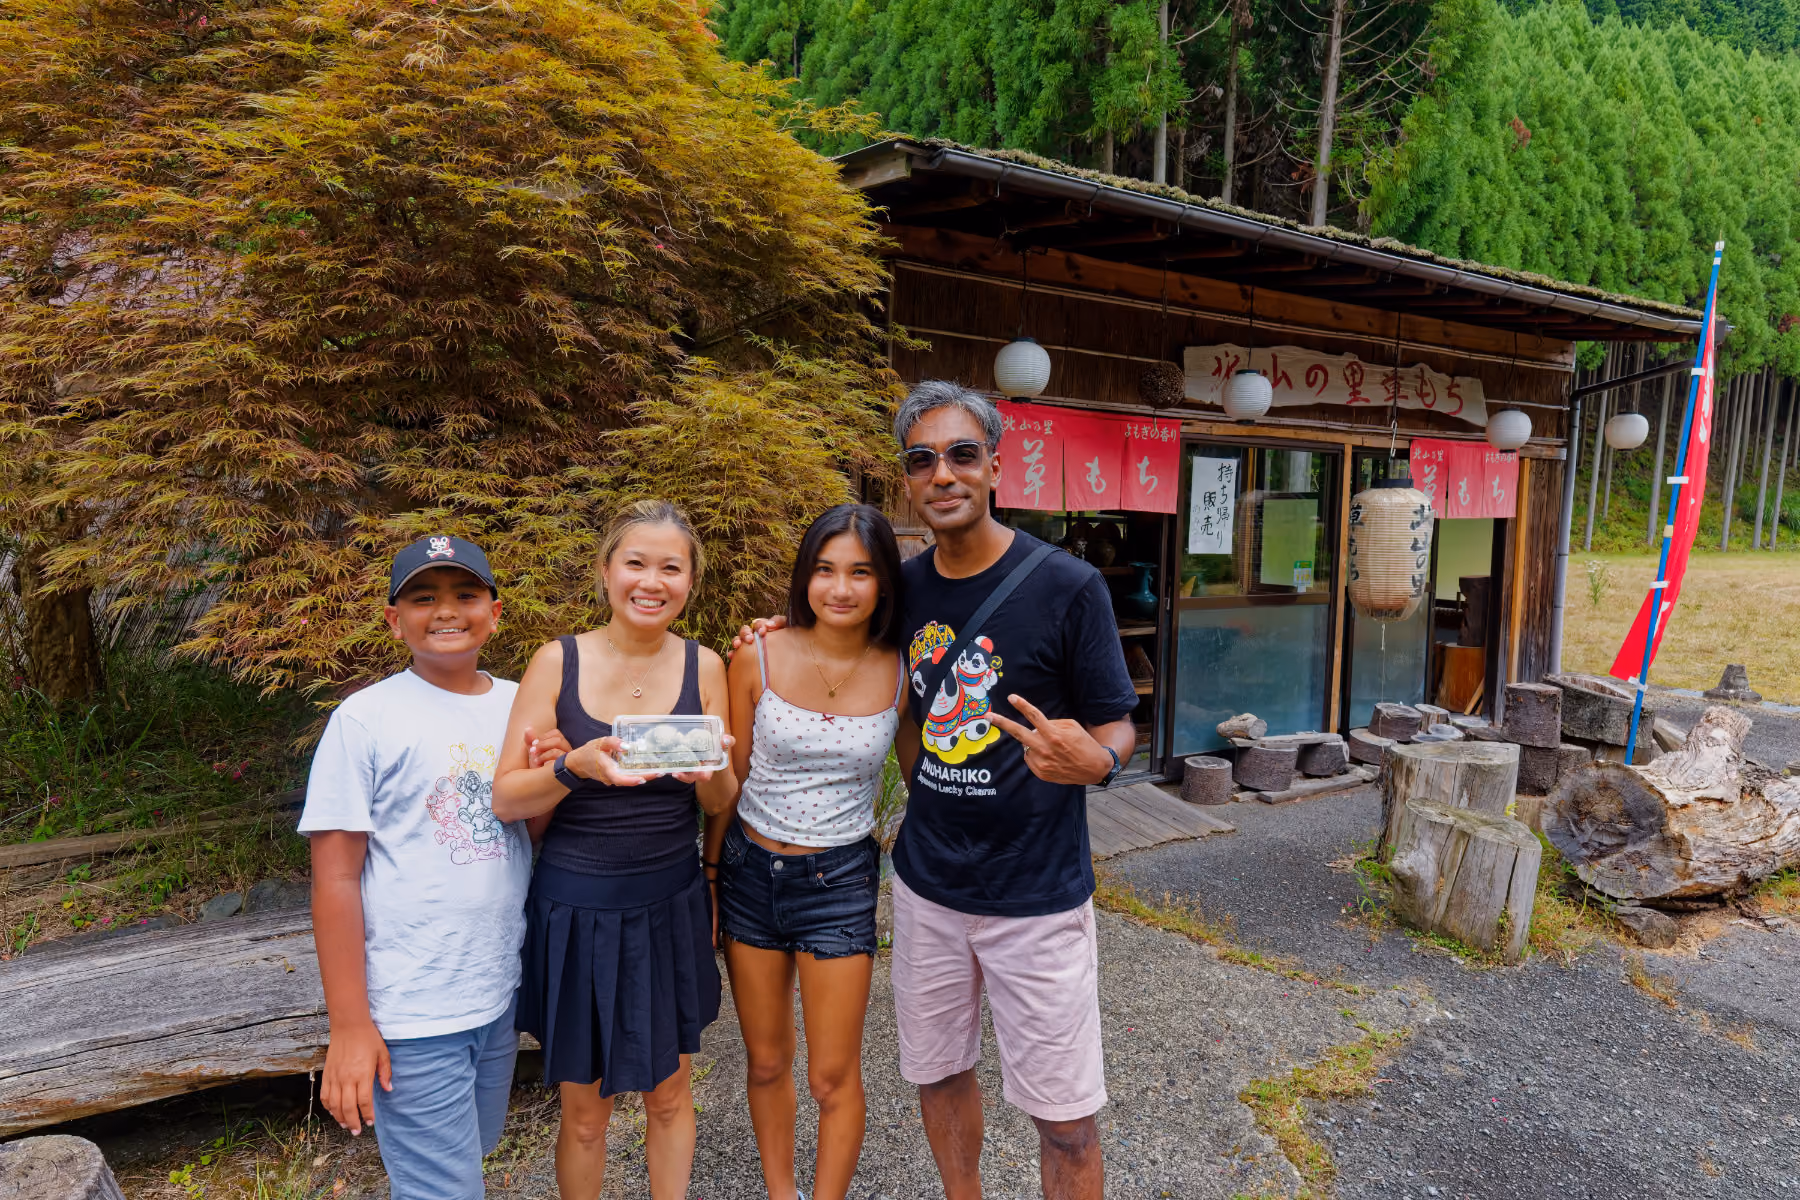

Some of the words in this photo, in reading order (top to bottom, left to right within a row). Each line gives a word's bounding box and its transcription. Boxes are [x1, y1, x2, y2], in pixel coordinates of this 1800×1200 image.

[1201, 491, 1216, 536] 販売
[1217, 463, 1233, 548] 持ち帰り
[921, 756, 991, 783] INUHARIKO
[938, 782, 963, 796] Lucky
[965, 785, 997, 796] Charm
